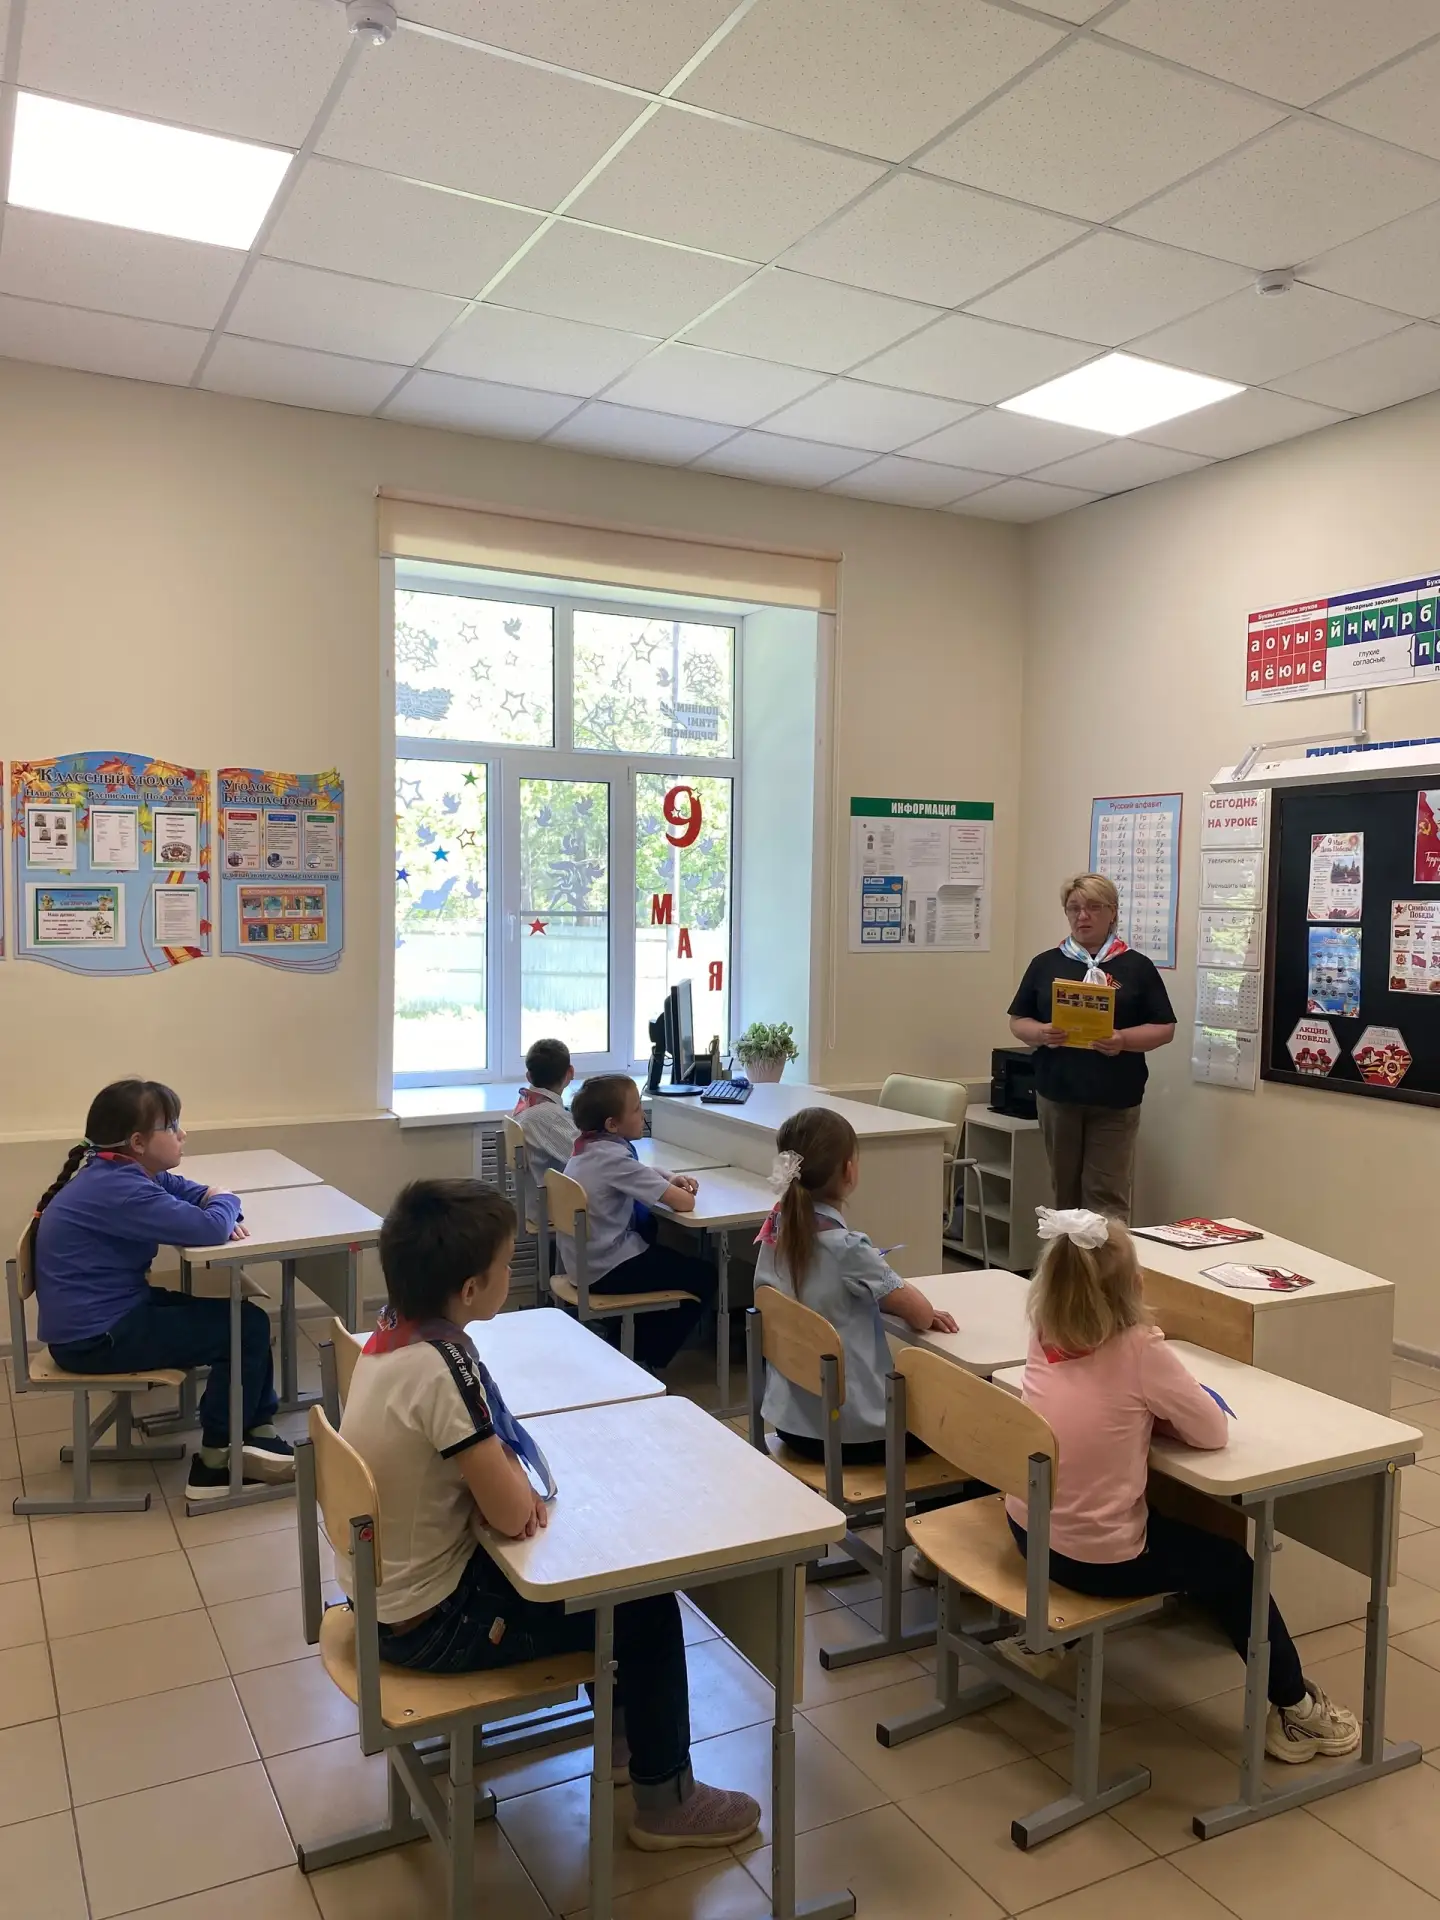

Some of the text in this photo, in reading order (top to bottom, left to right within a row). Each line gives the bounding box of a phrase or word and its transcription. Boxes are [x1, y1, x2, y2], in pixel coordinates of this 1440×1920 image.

[1345, 596, 1398, 611] Непарные звонкие
[1258, 604, 1318, 620] Буквы гласных звуков
[1358, 648, 1380, 658] глухие
[1352, 656, 1386, 666] согласные
[1109, 801, 1162, 810] Русский алфавит
[1209, 796, 1258, 809] СЕГОДНЯ
[891, 802, 956, 816] ИНФОРМАЦИЯ
[663, 785, 703, 848] 9
[1207, 816, 1258, 828] НА УРОКЕ
[1207, 857, 1236, 865] Увеличить
[1207, 881, 1238, 890] Уменьшить
[1299, 1026, 1328, 1035] АКЦИИ
[1295, 1034, 1331, 1044] ПОБЕДЫ
[459, 1365, 474, 1386] NIKE
